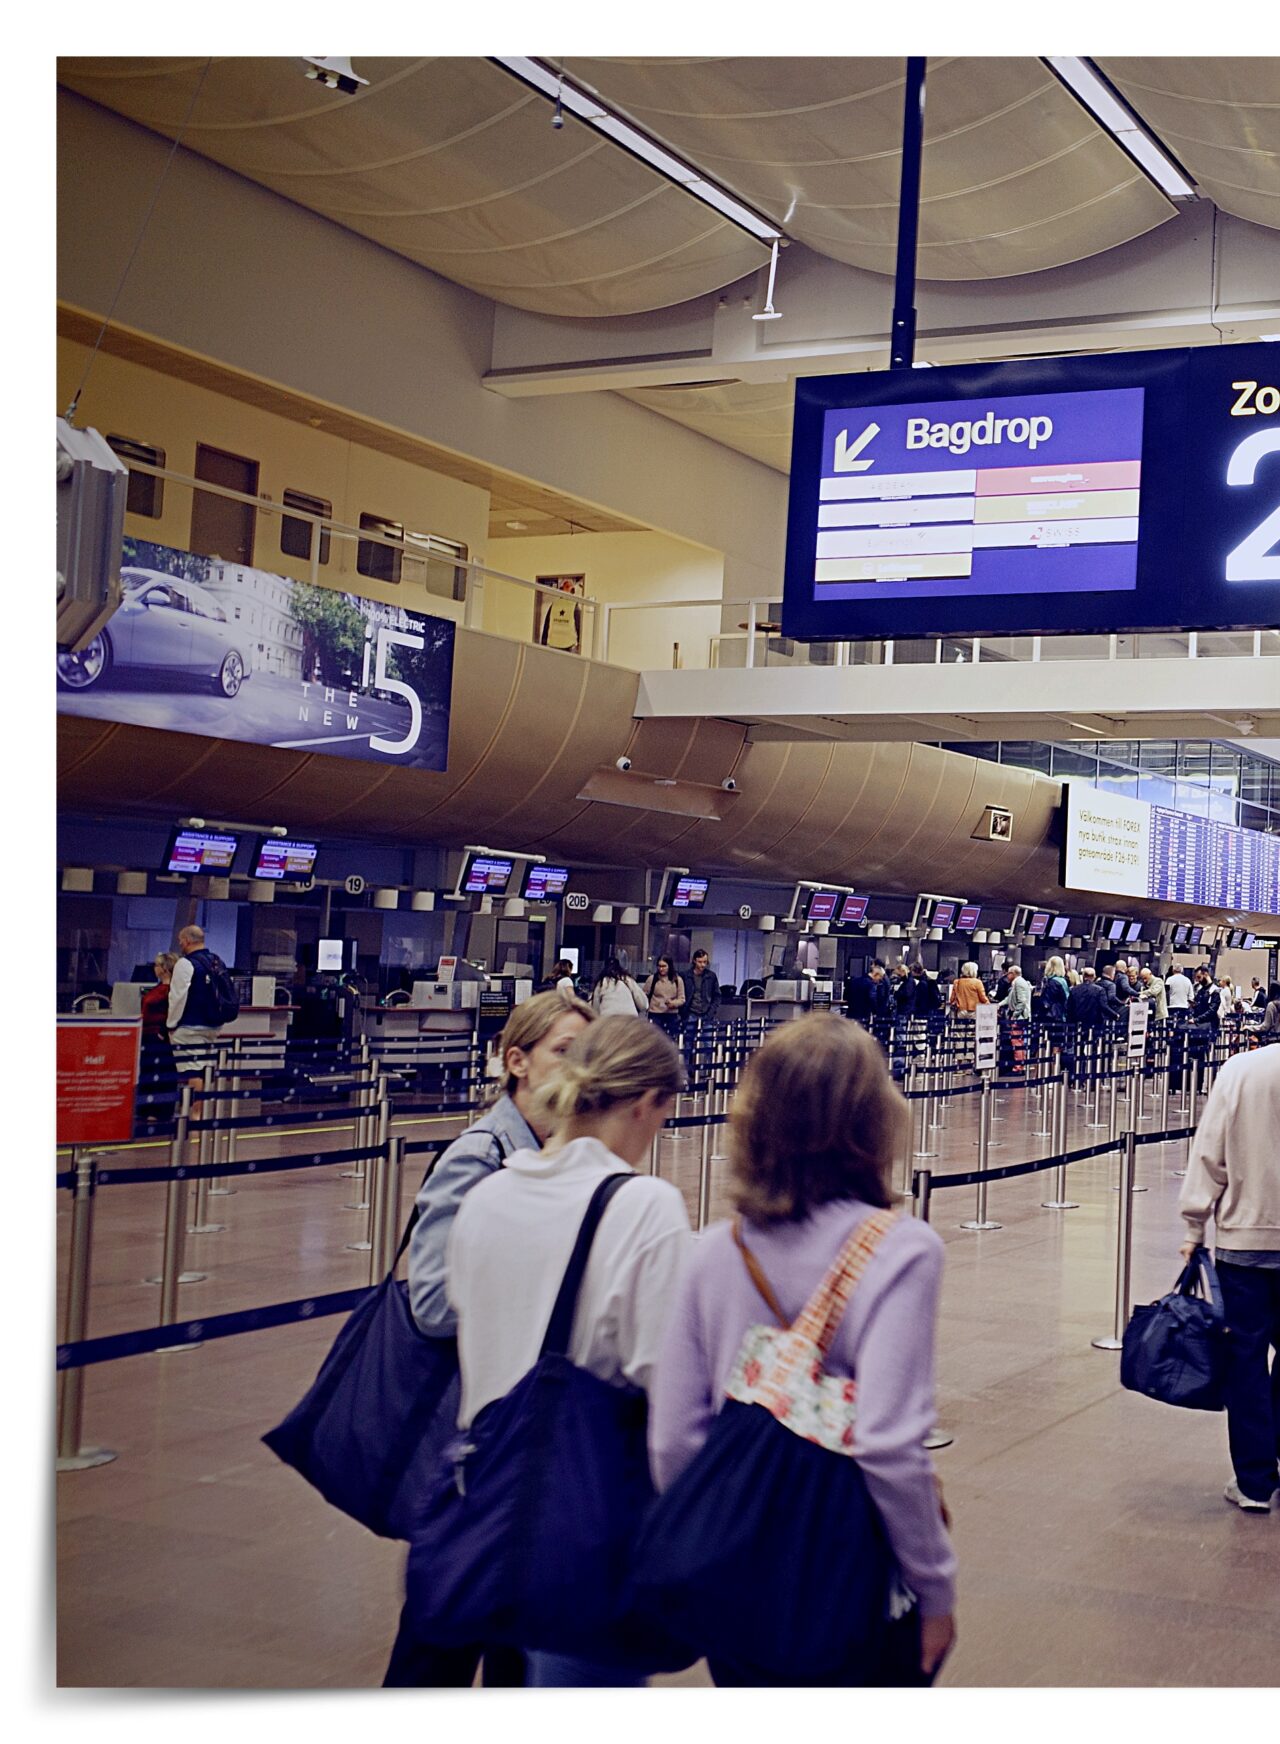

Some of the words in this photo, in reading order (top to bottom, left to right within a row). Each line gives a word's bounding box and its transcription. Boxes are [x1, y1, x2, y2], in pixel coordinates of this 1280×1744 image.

[905, 410, 1054, 455] Bagdrop
[390, 614, 426, 633] ELECTRIC
[301, 682, 358, 708] THE
[298, 707, 359, 731] NEW
[348, 877, 362, 892] 19
[568, 895, 587, 908] 20B
[741, 906, 750, 917] 21
